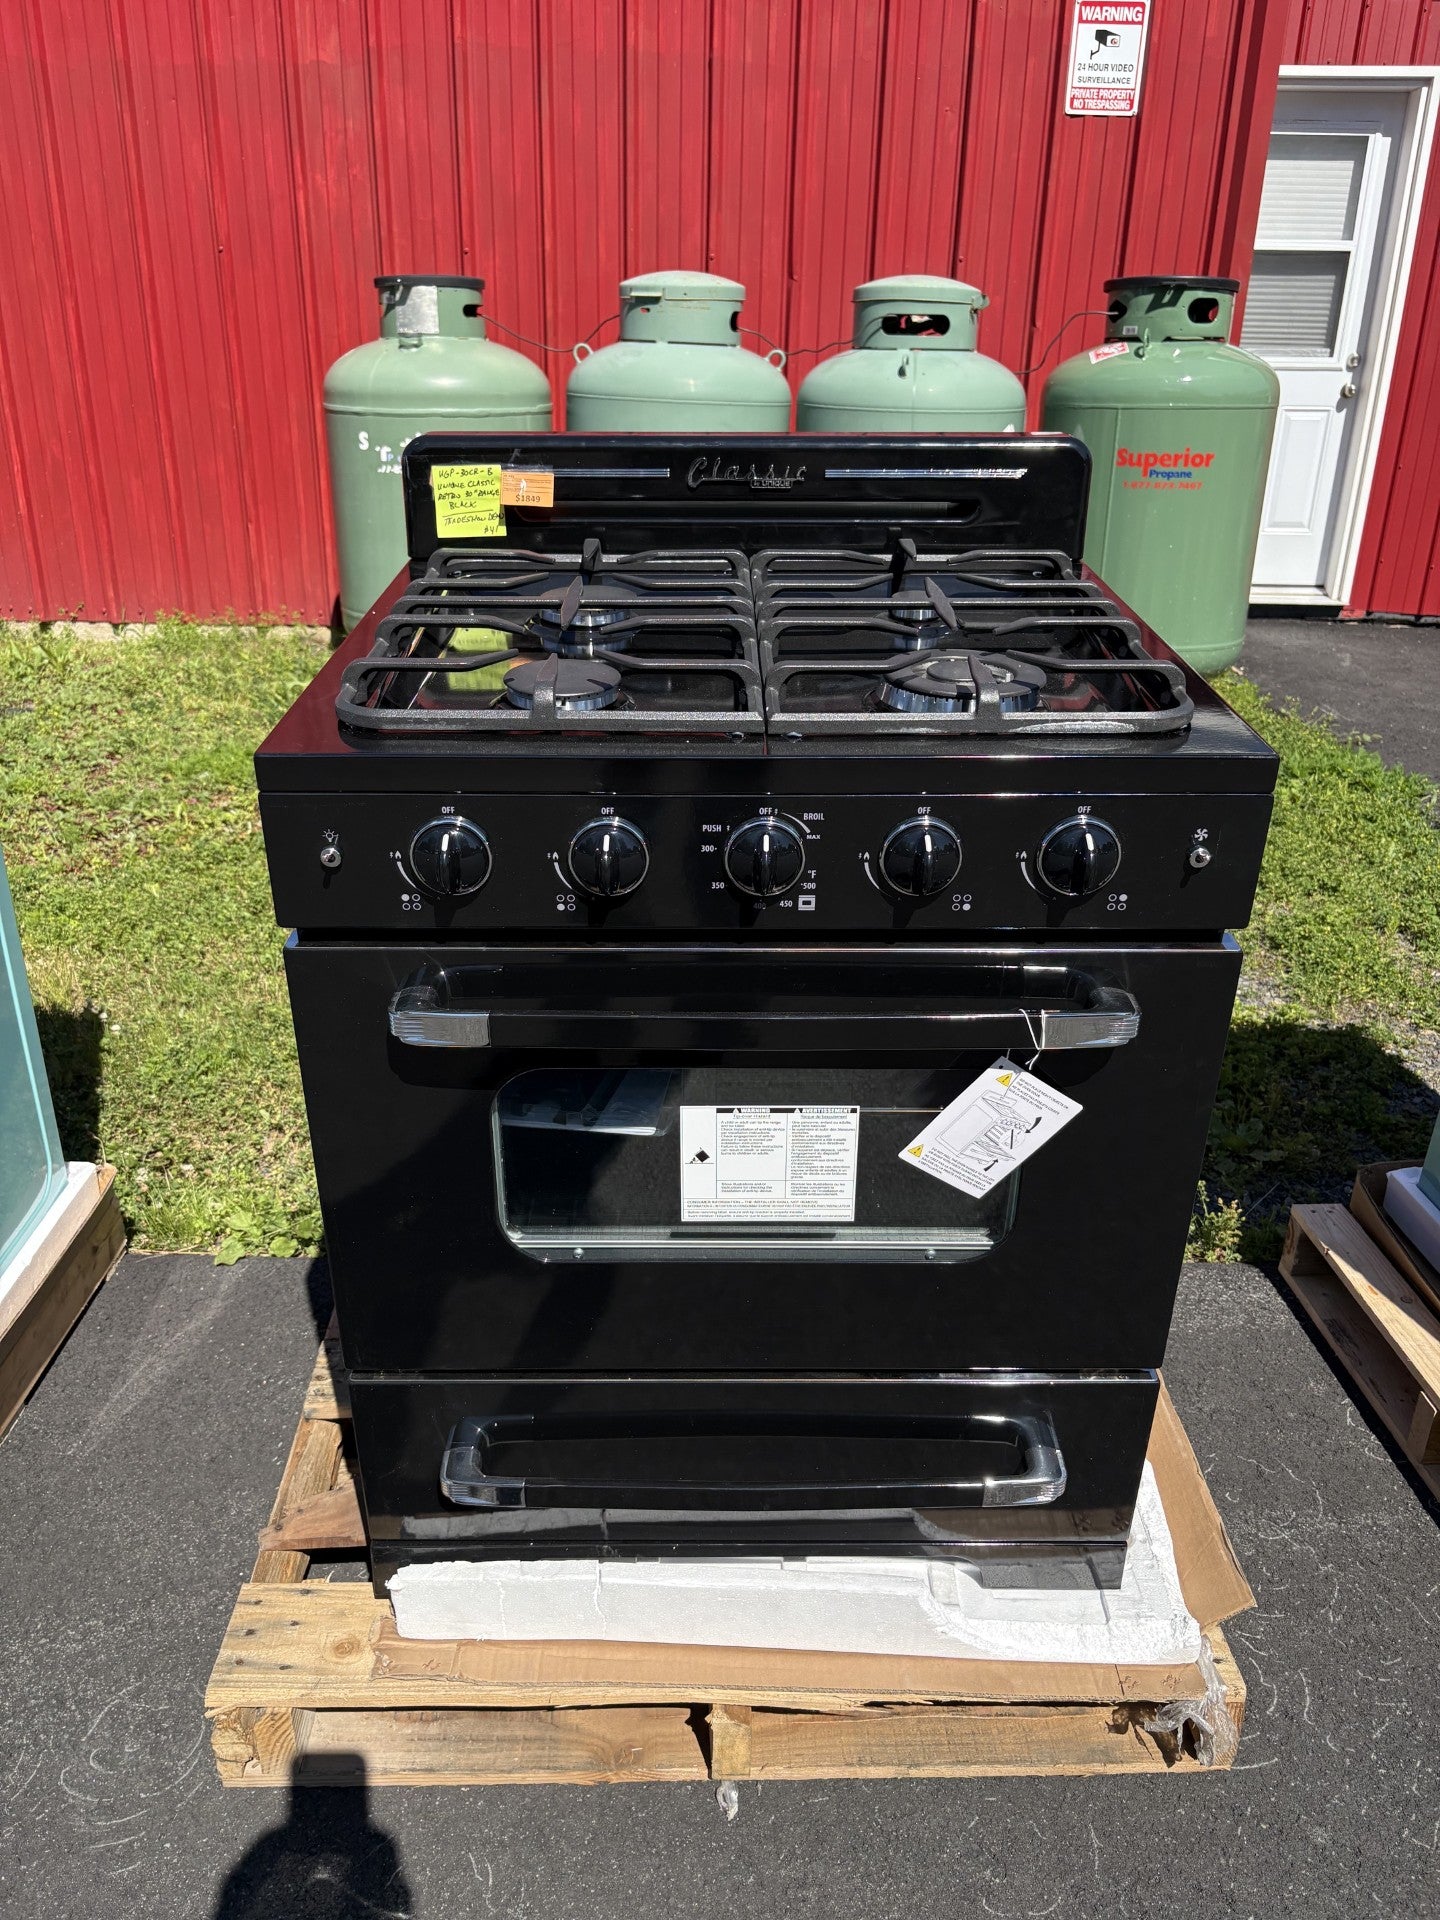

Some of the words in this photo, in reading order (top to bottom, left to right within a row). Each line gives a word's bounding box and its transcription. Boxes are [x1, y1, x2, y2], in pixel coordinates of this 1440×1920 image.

[1081, 5, 1143, 22] WARNING
[1077, 62, 1086, 71] 24
[1087, 63, 1109, 72] HOUR
[1110, 63, 1134, 73] VIDEO
[1077, 75, 1131, 85] SURVEILLANCE
[1071, 88, 1098, 99] PRIVATE
[1099, 89, 1135, 100] PROPERTY
[1073, 99, 1083, 109] NO
[1084, 99, 1131, 110] TRESPASSING
[1115, 447, 1215, 478] Superior
[686, 456, 808, 488] Classic
[1149, 469, 1193, 480] Propane
[467, 479, 496, 488] CLASSIC
[515, 493, 541, 503] $1849
[449, 501, 477, 510] BLACK
[441, 806, 455, 814] OFF
[601, 807, 615, 815] OFF
[758, 807, 773, 815] OFF
[917, 806, 931, 815] OFF
[1077, 805, 1092, 814] OFF
[803, 812, 825, 821] BROIL
[702, 824, 722, 832] PUSH
[700, 844, 715, 853] 300
[711, 881, 725, 889] 350
[803, 882, 816, 890] 500
[779, 900, 793, 908] 450
